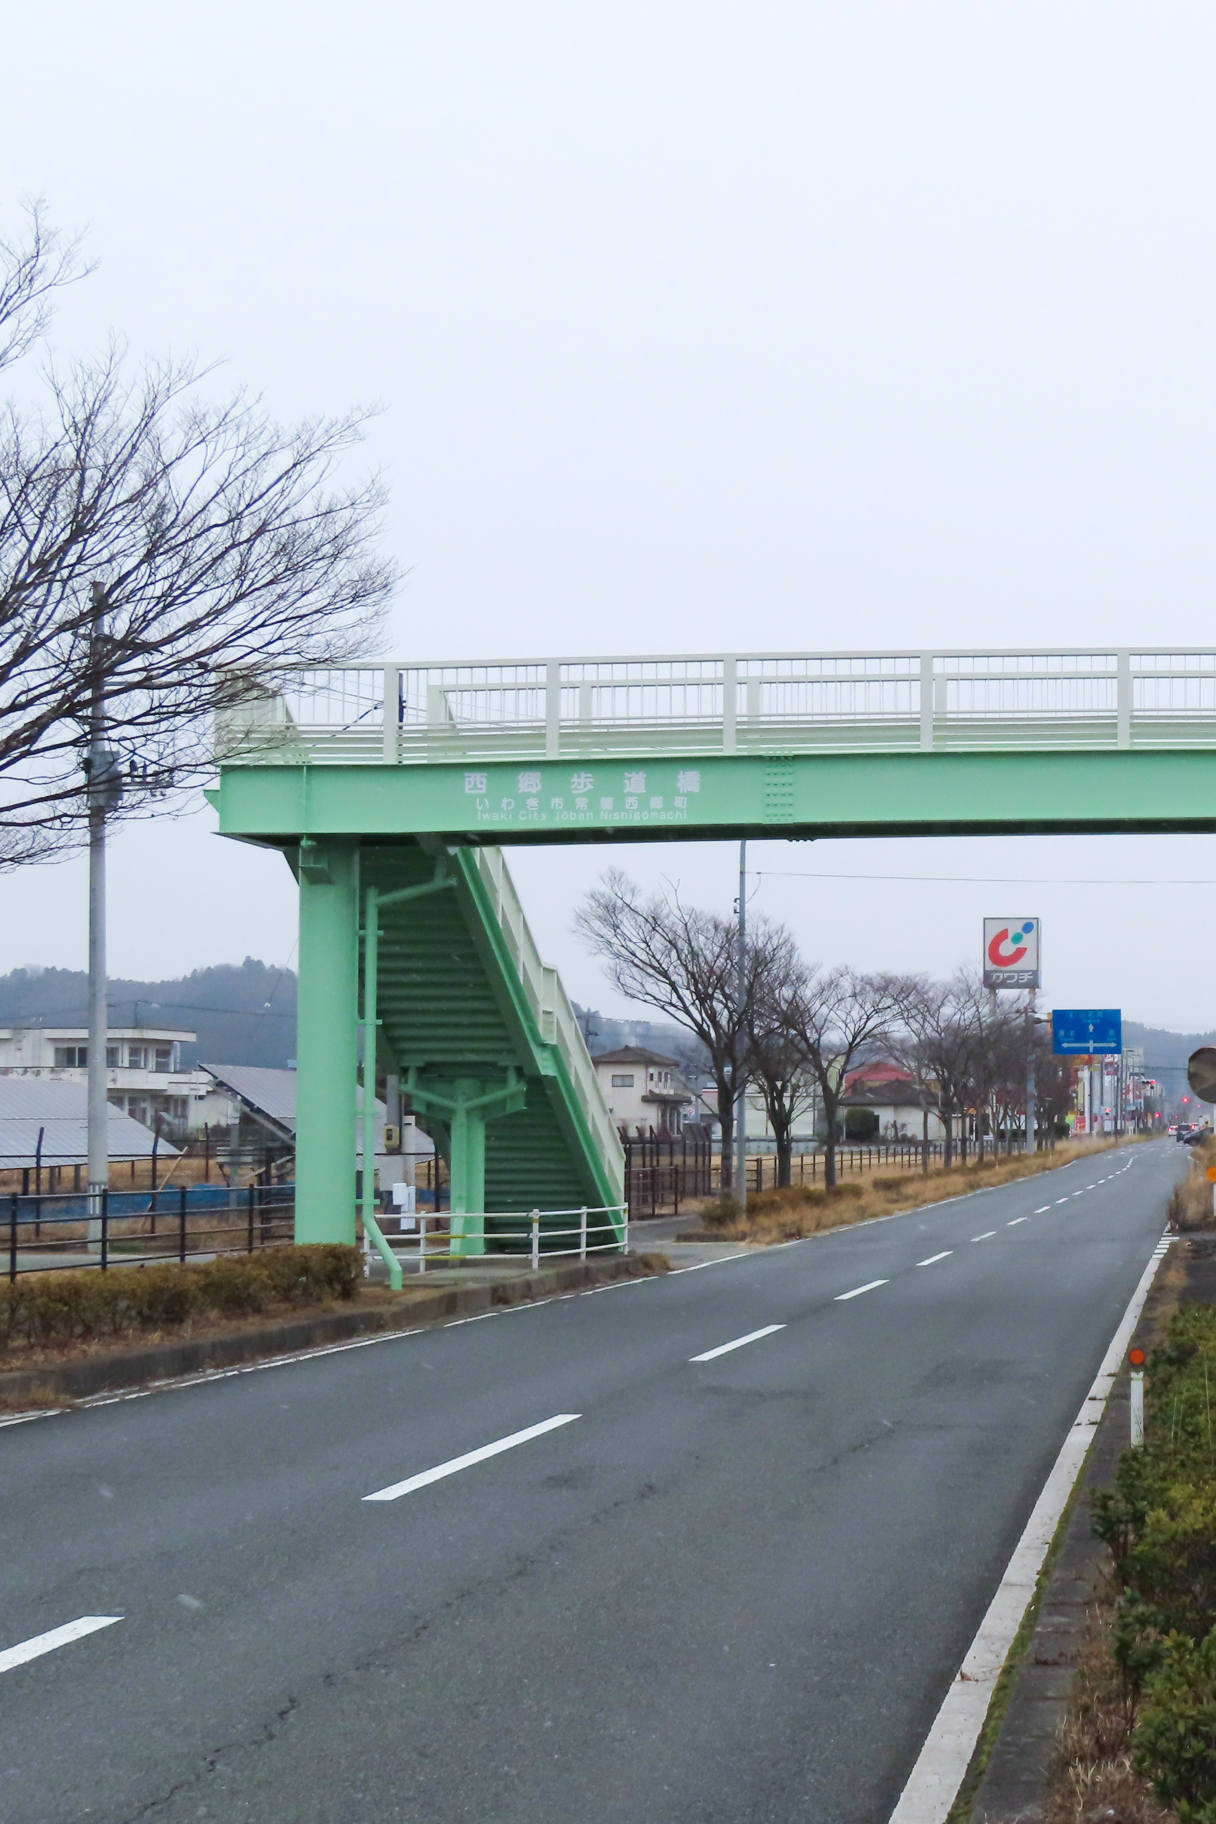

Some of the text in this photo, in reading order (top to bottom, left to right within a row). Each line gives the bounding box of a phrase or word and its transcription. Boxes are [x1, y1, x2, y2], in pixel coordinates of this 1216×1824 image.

[464, 770, 702, 794] 西郷歩道橋
[477, 810, 512, 821] Iwaki
[518, 810, 547, 821] City
[990, 971, 1034, 983] カワチ
